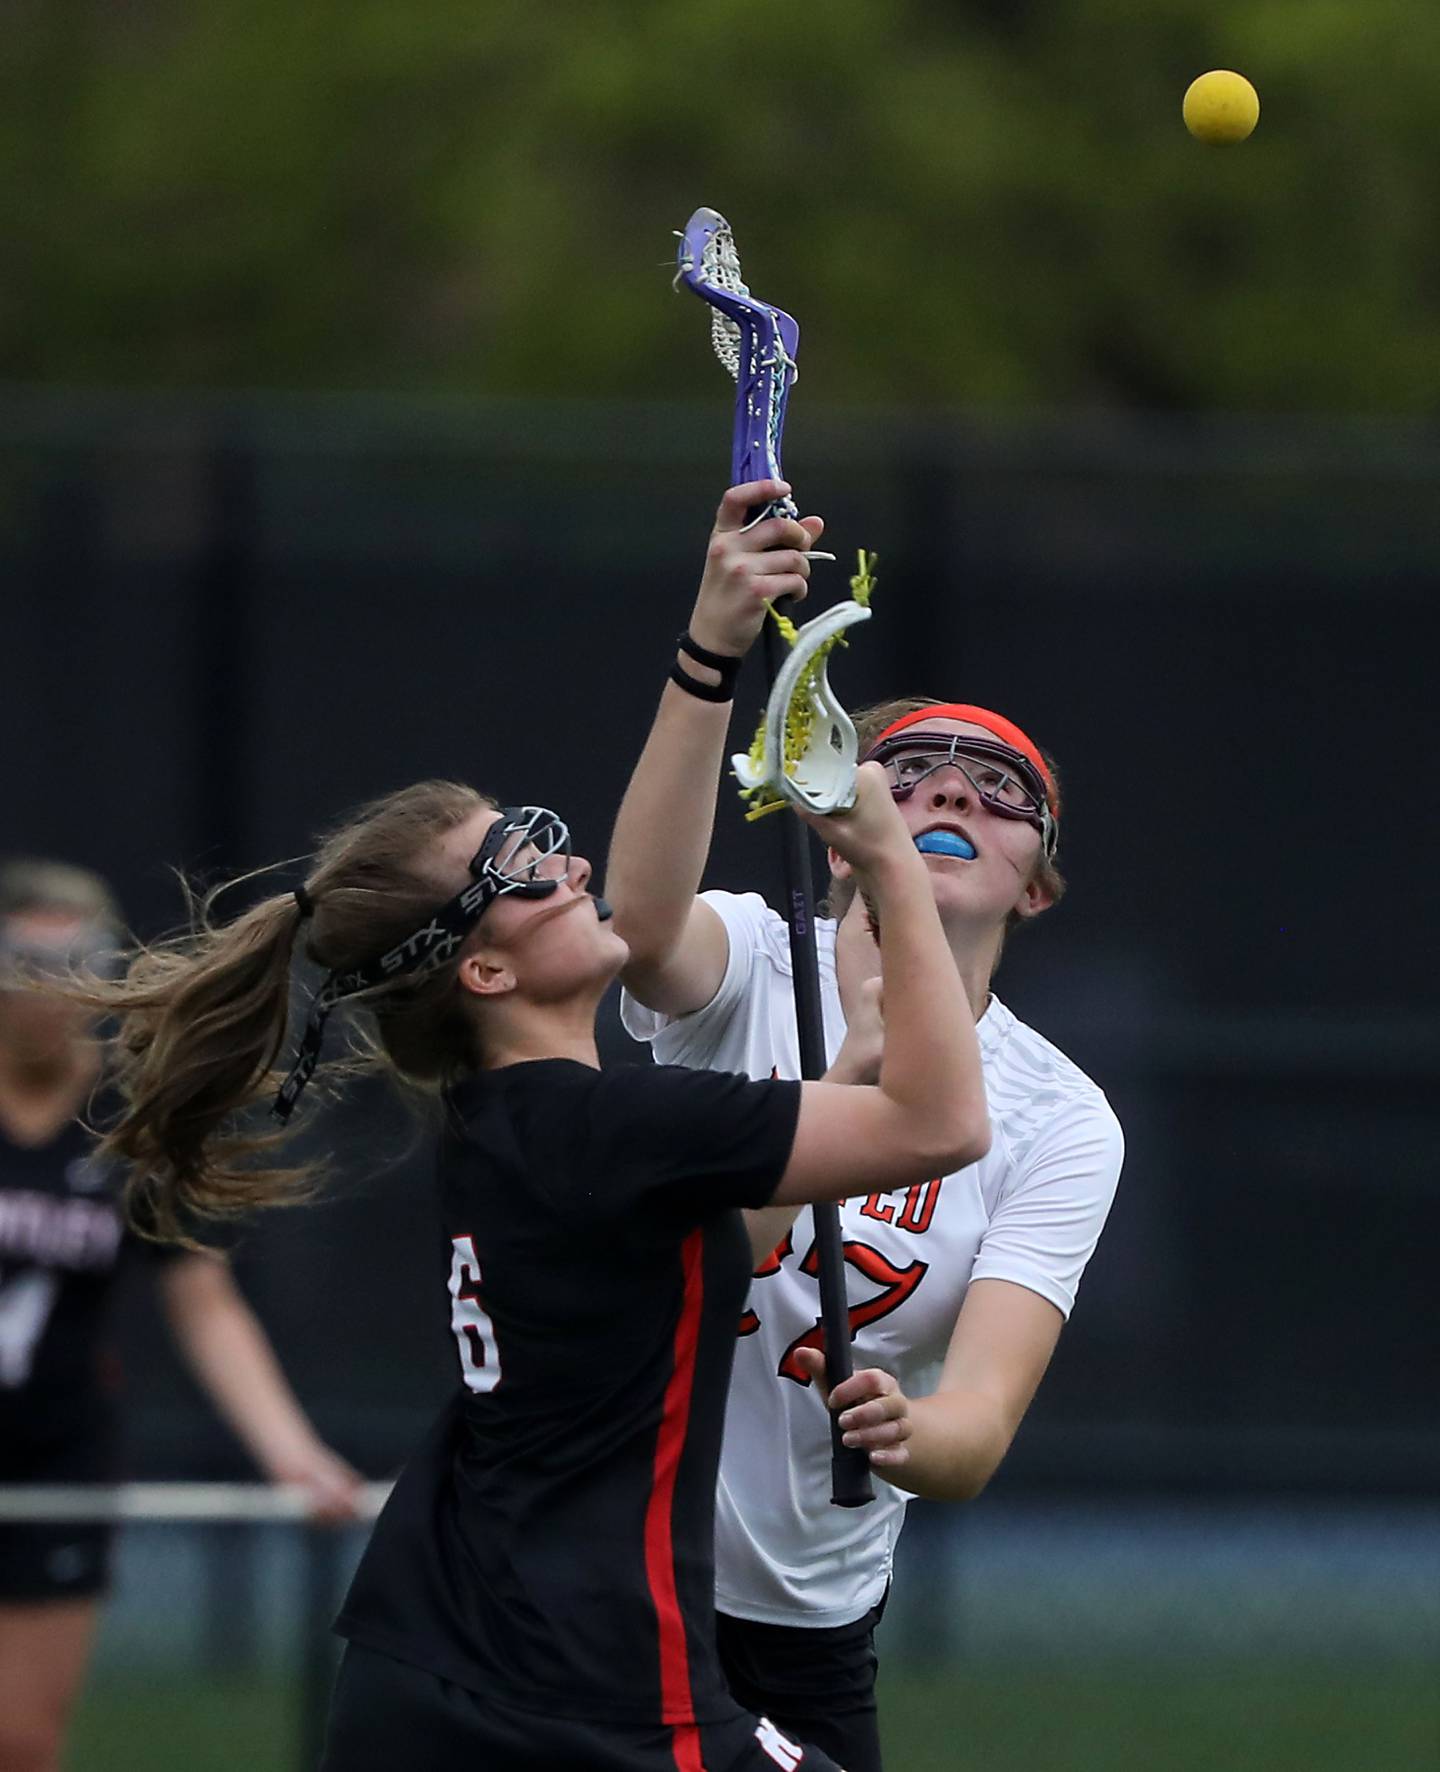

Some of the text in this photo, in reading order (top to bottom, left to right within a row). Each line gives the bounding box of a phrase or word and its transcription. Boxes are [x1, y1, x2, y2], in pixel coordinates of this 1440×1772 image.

[379, 917, 447, 973] STX
[446, 1233, 502, 1395] 6
[738, 1229, 929, 1387] 7
